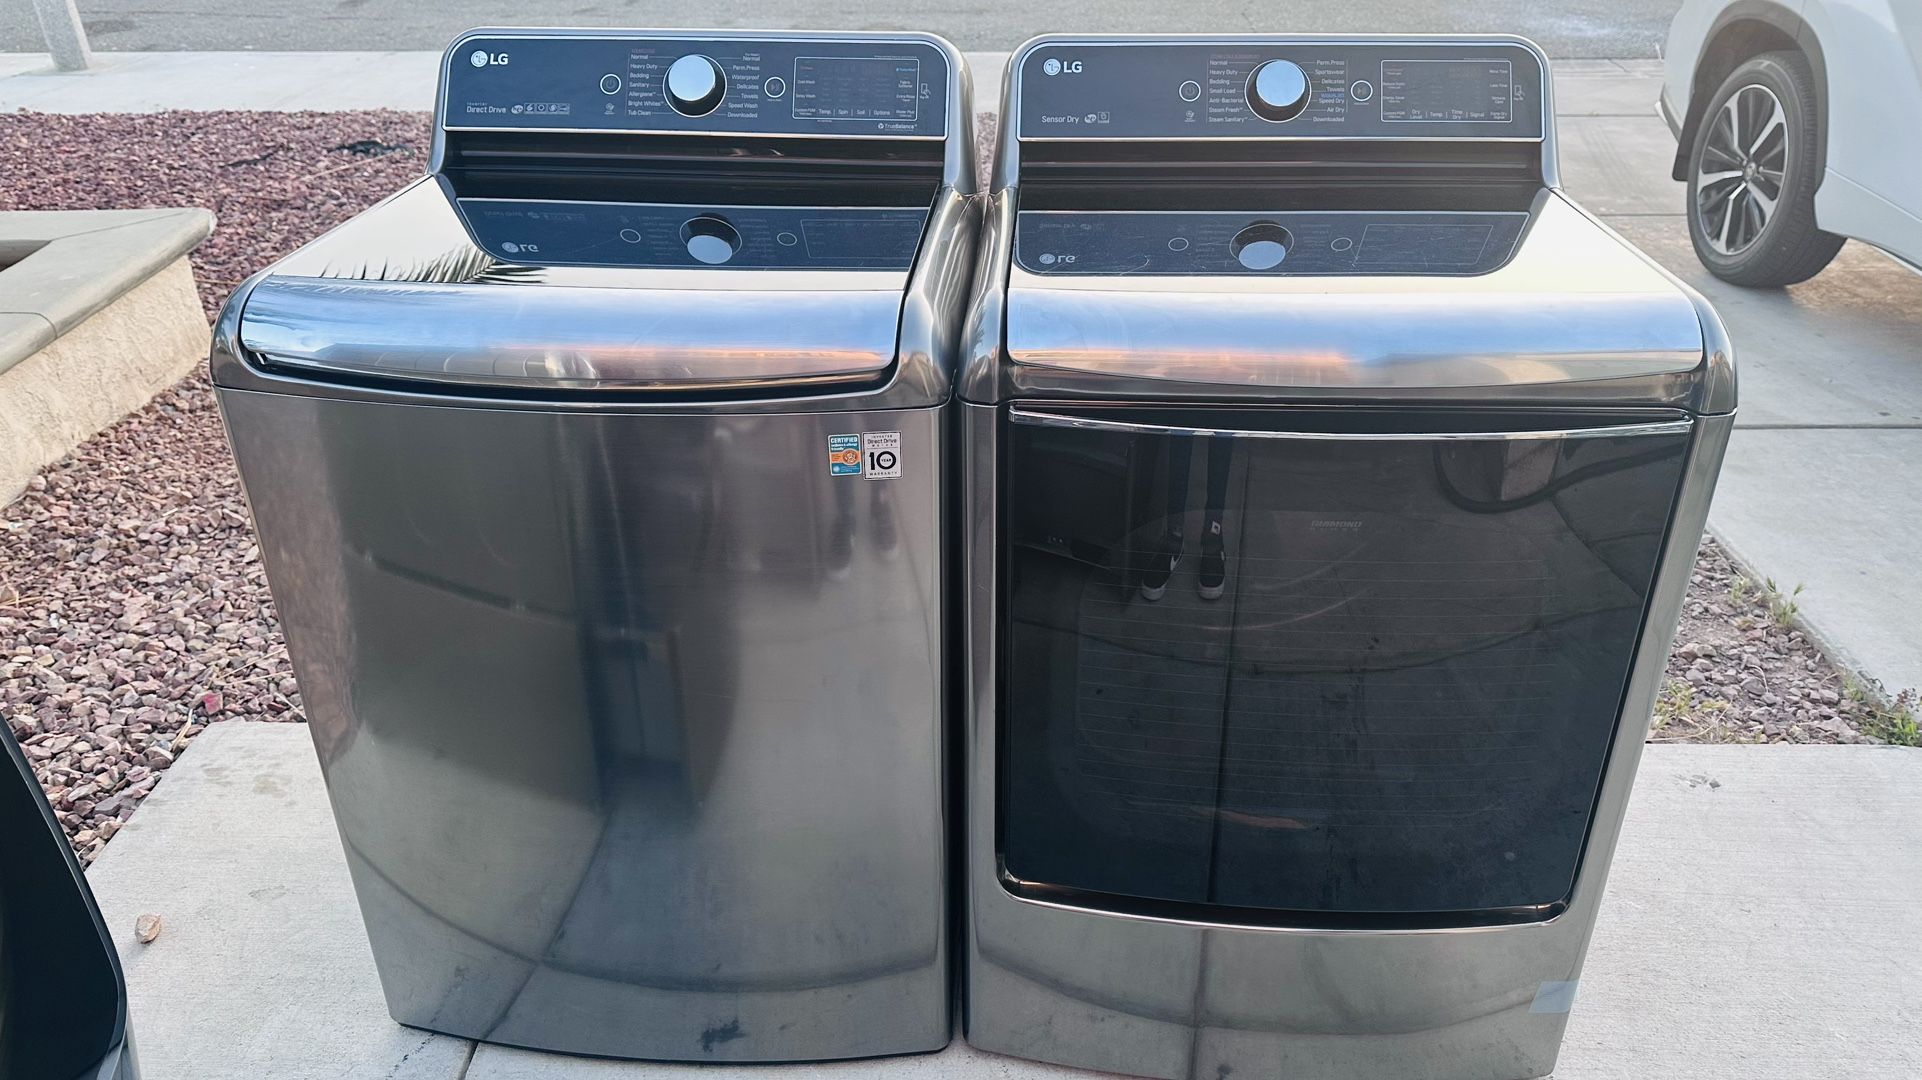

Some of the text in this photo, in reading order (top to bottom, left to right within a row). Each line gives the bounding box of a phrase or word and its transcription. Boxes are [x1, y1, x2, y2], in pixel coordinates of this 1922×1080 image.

[490, 53, 509, 65] LG
[1064, 61, 1083, 73] LG
[869, 451, 896, 470] 10
